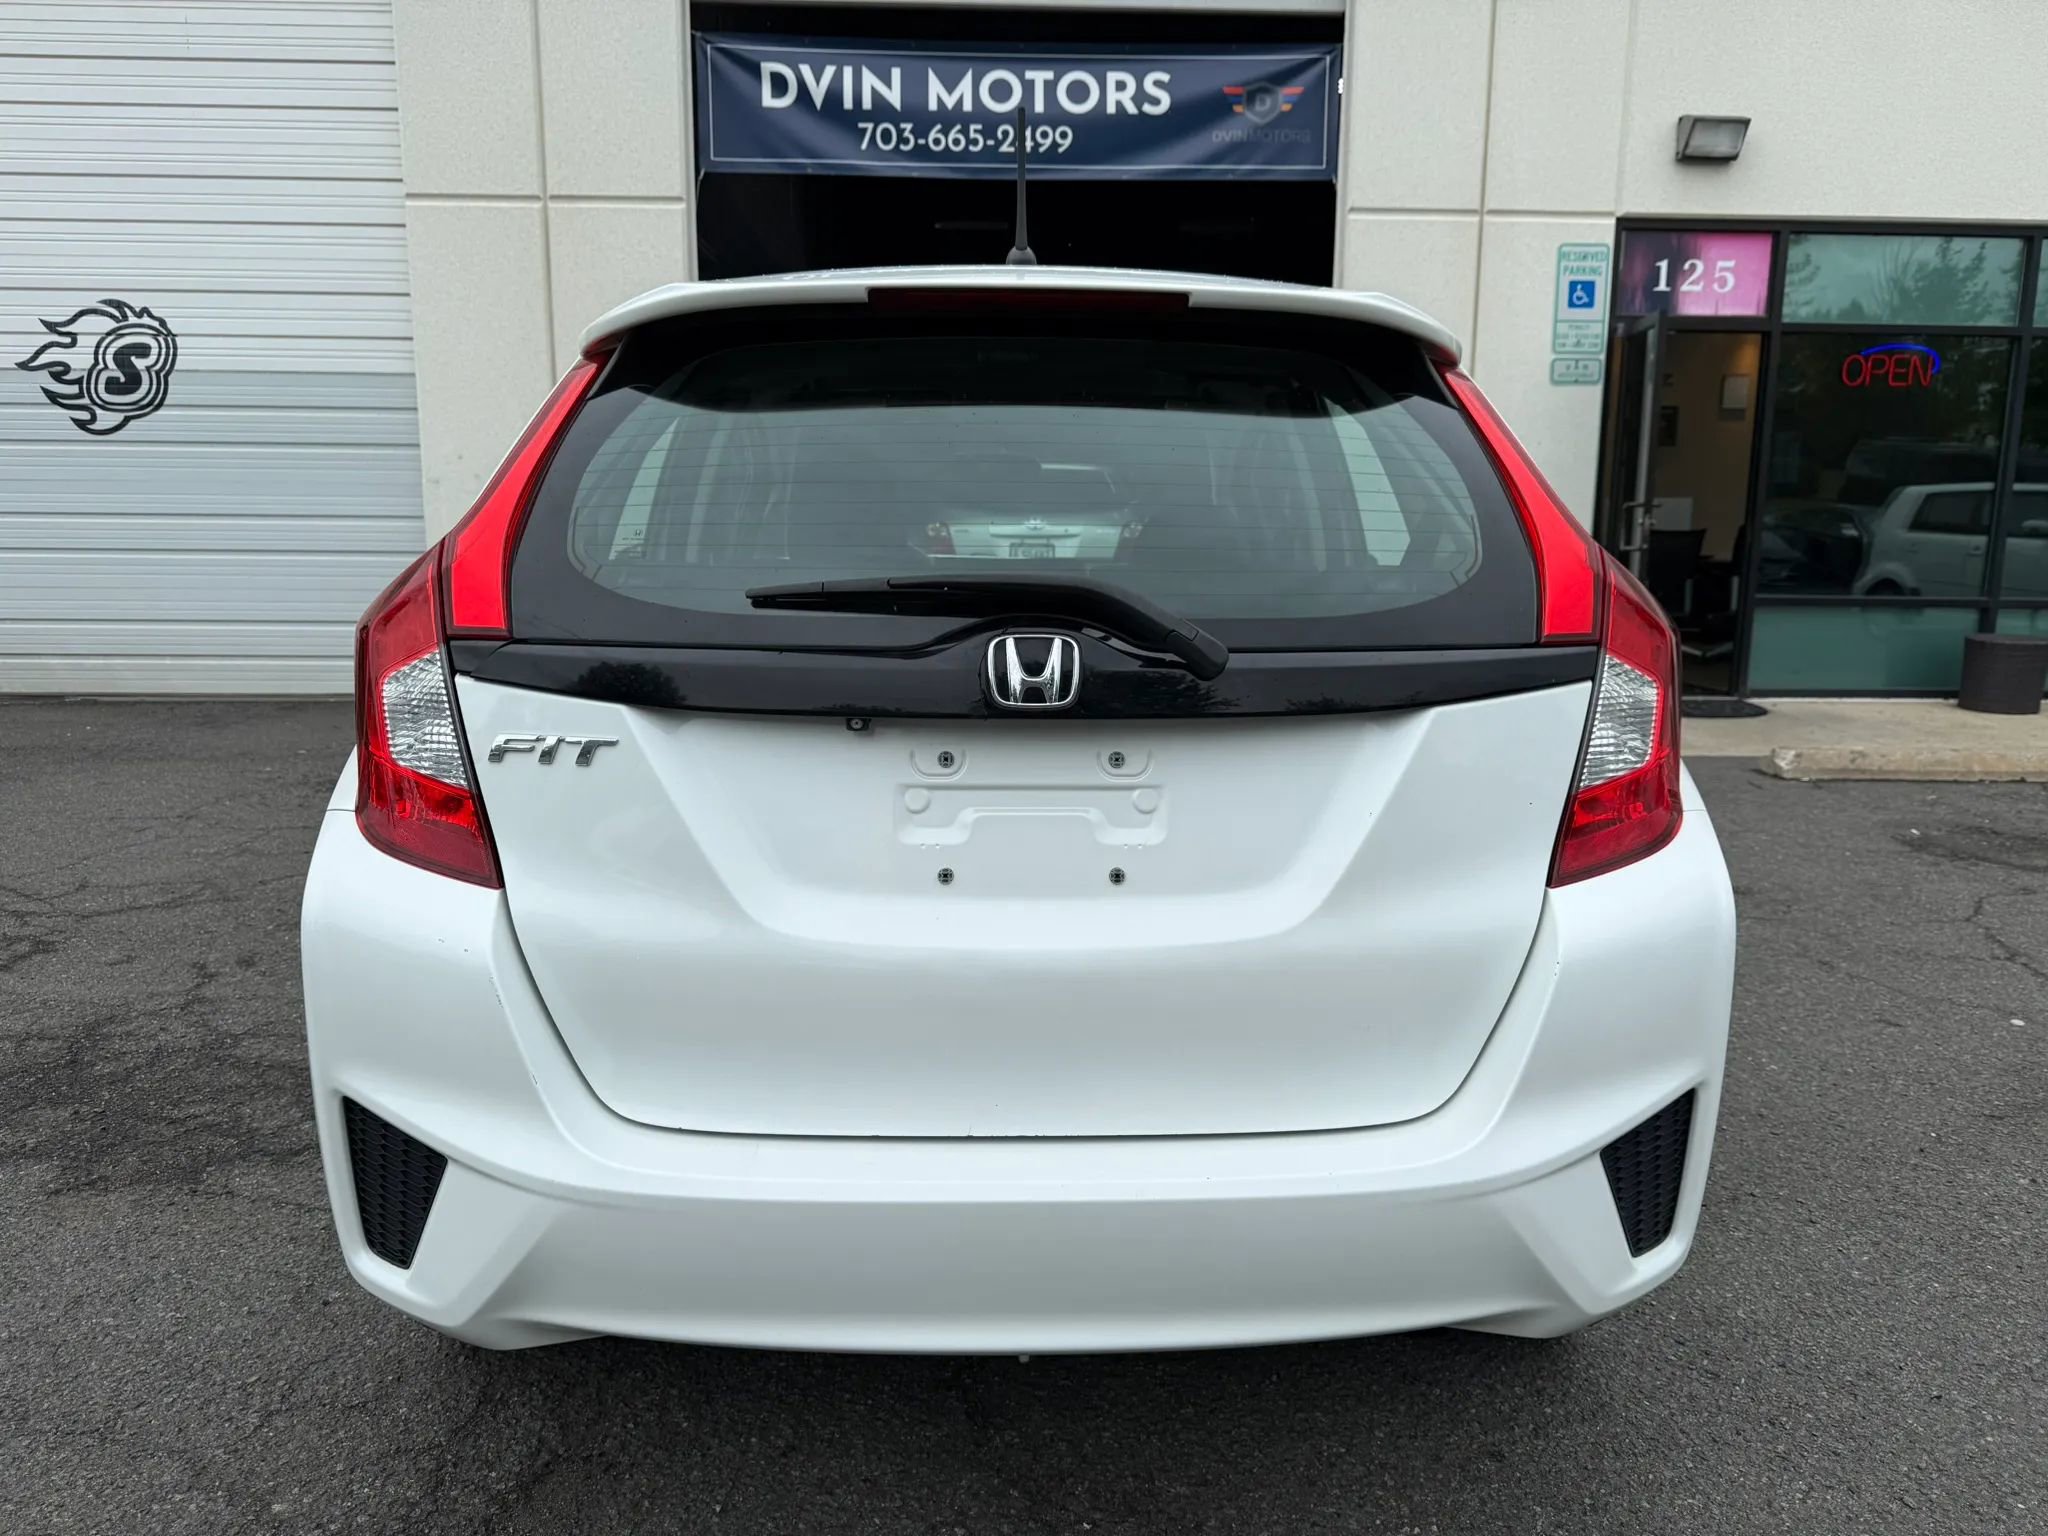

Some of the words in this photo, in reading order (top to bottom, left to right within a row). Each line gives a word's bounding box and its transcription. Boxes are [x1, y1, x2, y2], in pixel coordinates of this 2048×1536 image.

[760, 61, 902, 112] DVIN
[927, 66, 1173, 116] MOTORS
[1562, 264, 1603, 276] PARKING
[1652, 258, 1737, 293] 125
[1841, 353, 1934, 388] OPEN
[488, 733, 620, 767] FIT
